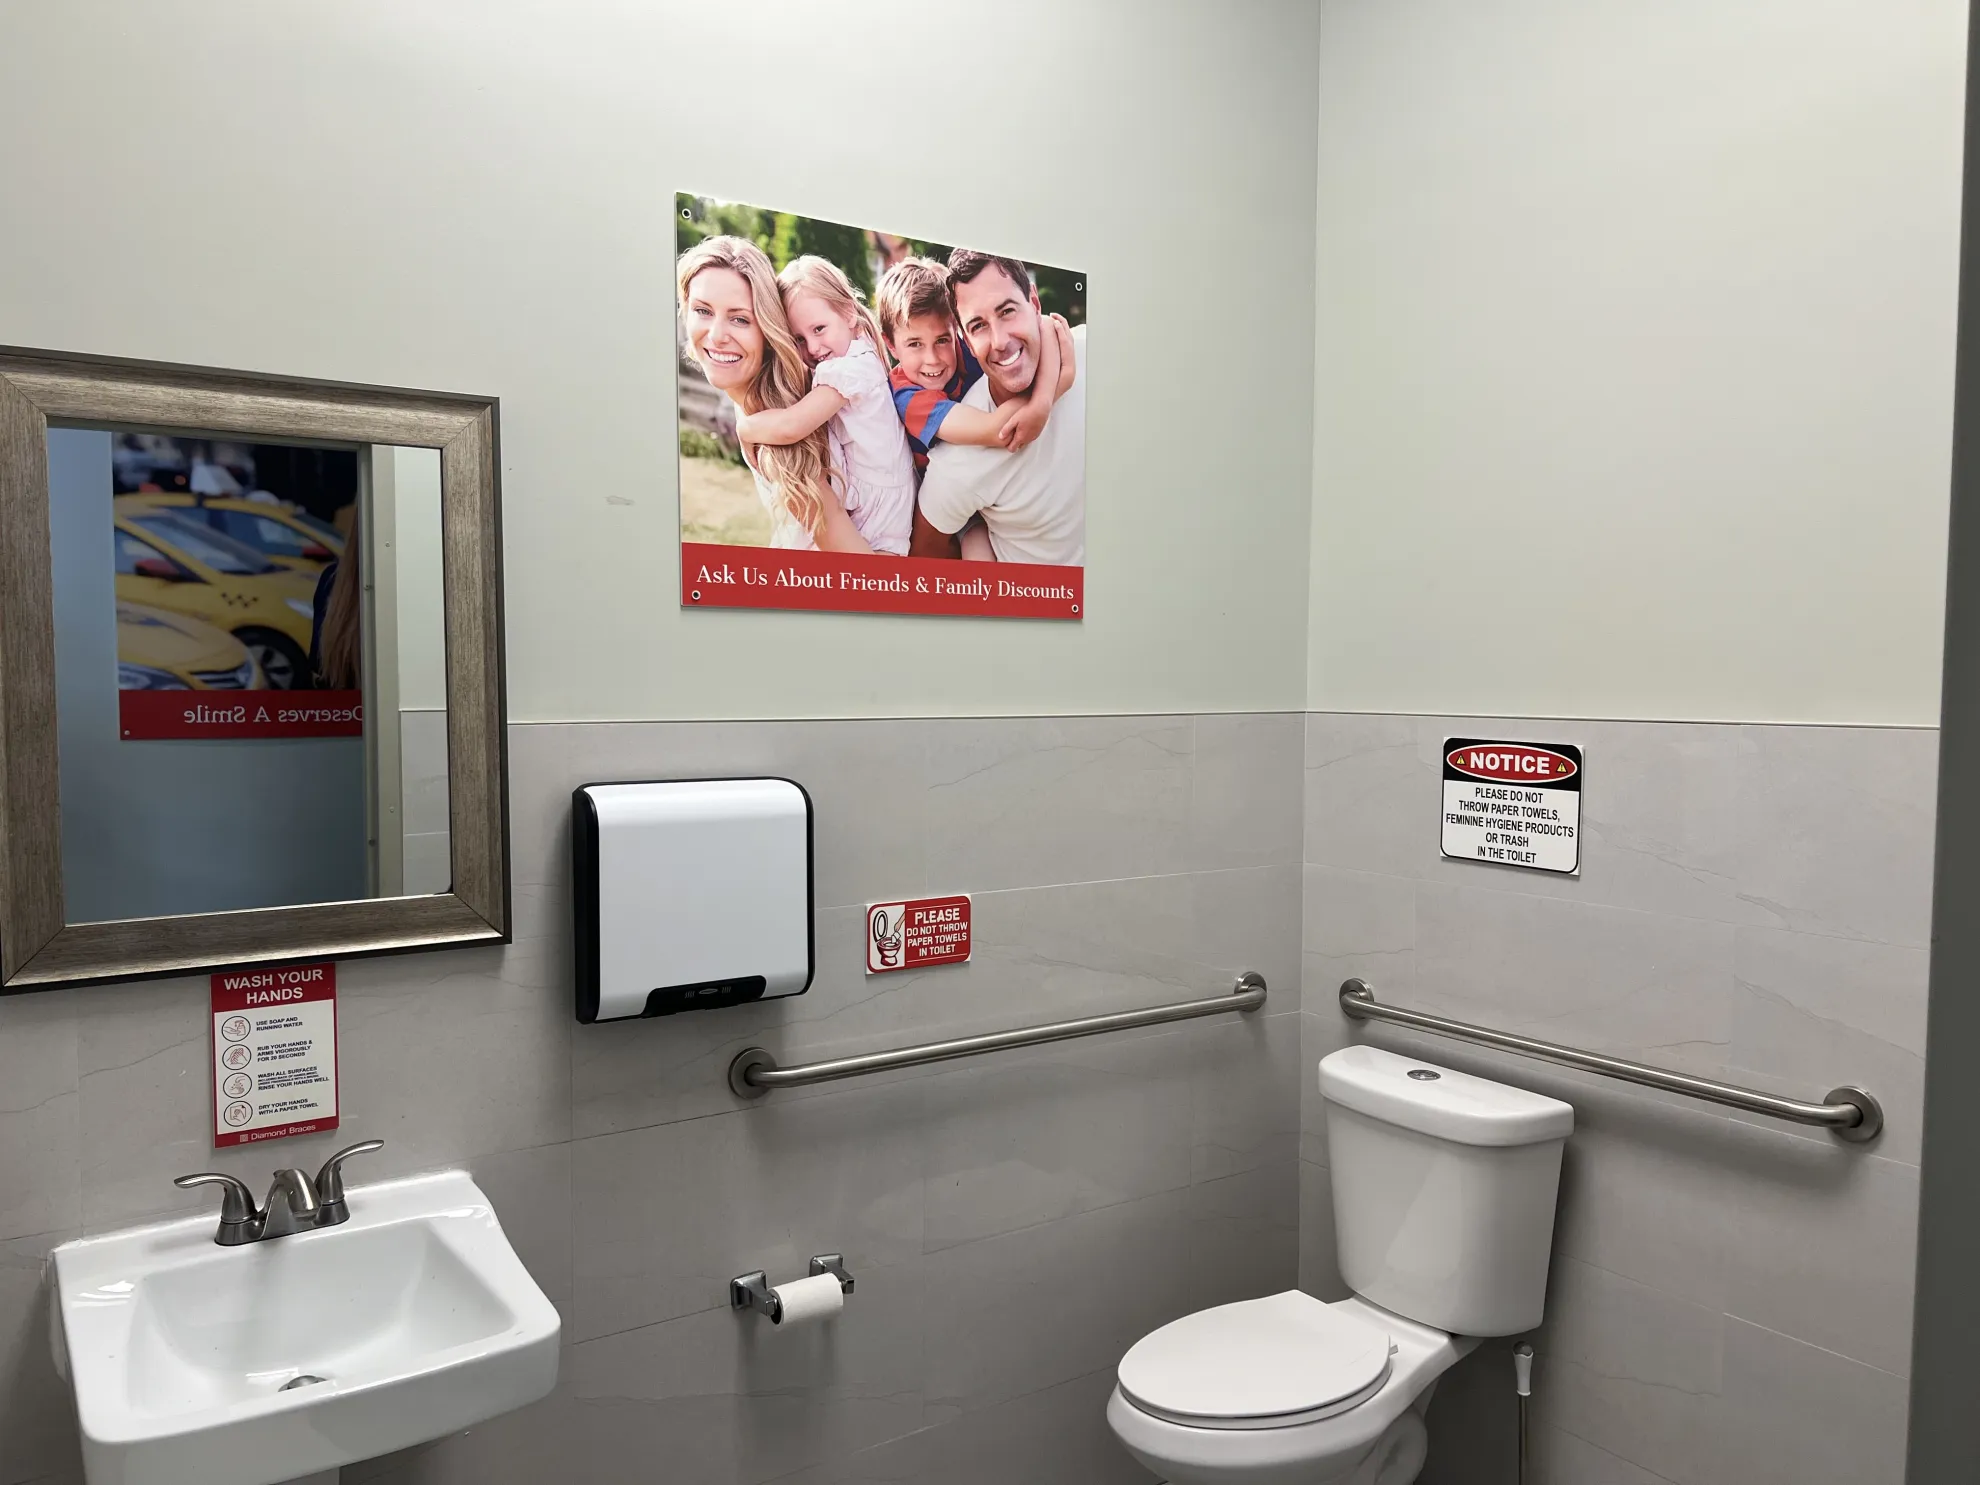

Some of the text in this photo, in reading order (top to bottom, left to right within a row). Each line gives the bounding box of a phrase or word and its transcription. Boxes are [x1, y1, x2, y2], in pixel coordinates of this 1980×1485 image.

[696, 564, 1074, 600] Ask Us About Friends & Family Discounts
[1470, 752, 1550, 774] NOTICE
[1476, 787, 1543, 803] PLEASE DO NOT
[1459, 800, 1560, 822] THROW PAPER TOWELS,
[1446, 813, 1574, 837] FEMININE HYGIENE PRODUCTS
[1486, 833, 1529, 847] OR TRASH
[1478, 846, 1536, 863] IN THE TOILET
[915, 908, 960, 925] PLEASE
[907, 922, 968, 937] DO NOT THROW
[908, 932, 967, 947] PAPER TOWELS
[919, 944, 956, 957] IN TOILET
[224, 969, 323, 990] WASH YOUR
[247, 987, 304, 1004] HANDS
[275, 1045, 311, 1054] VIGOROUSLY
[288, 1066, 317, 1074] SURFACES
[251, 1124, 316, 1140] Diamond Braces
